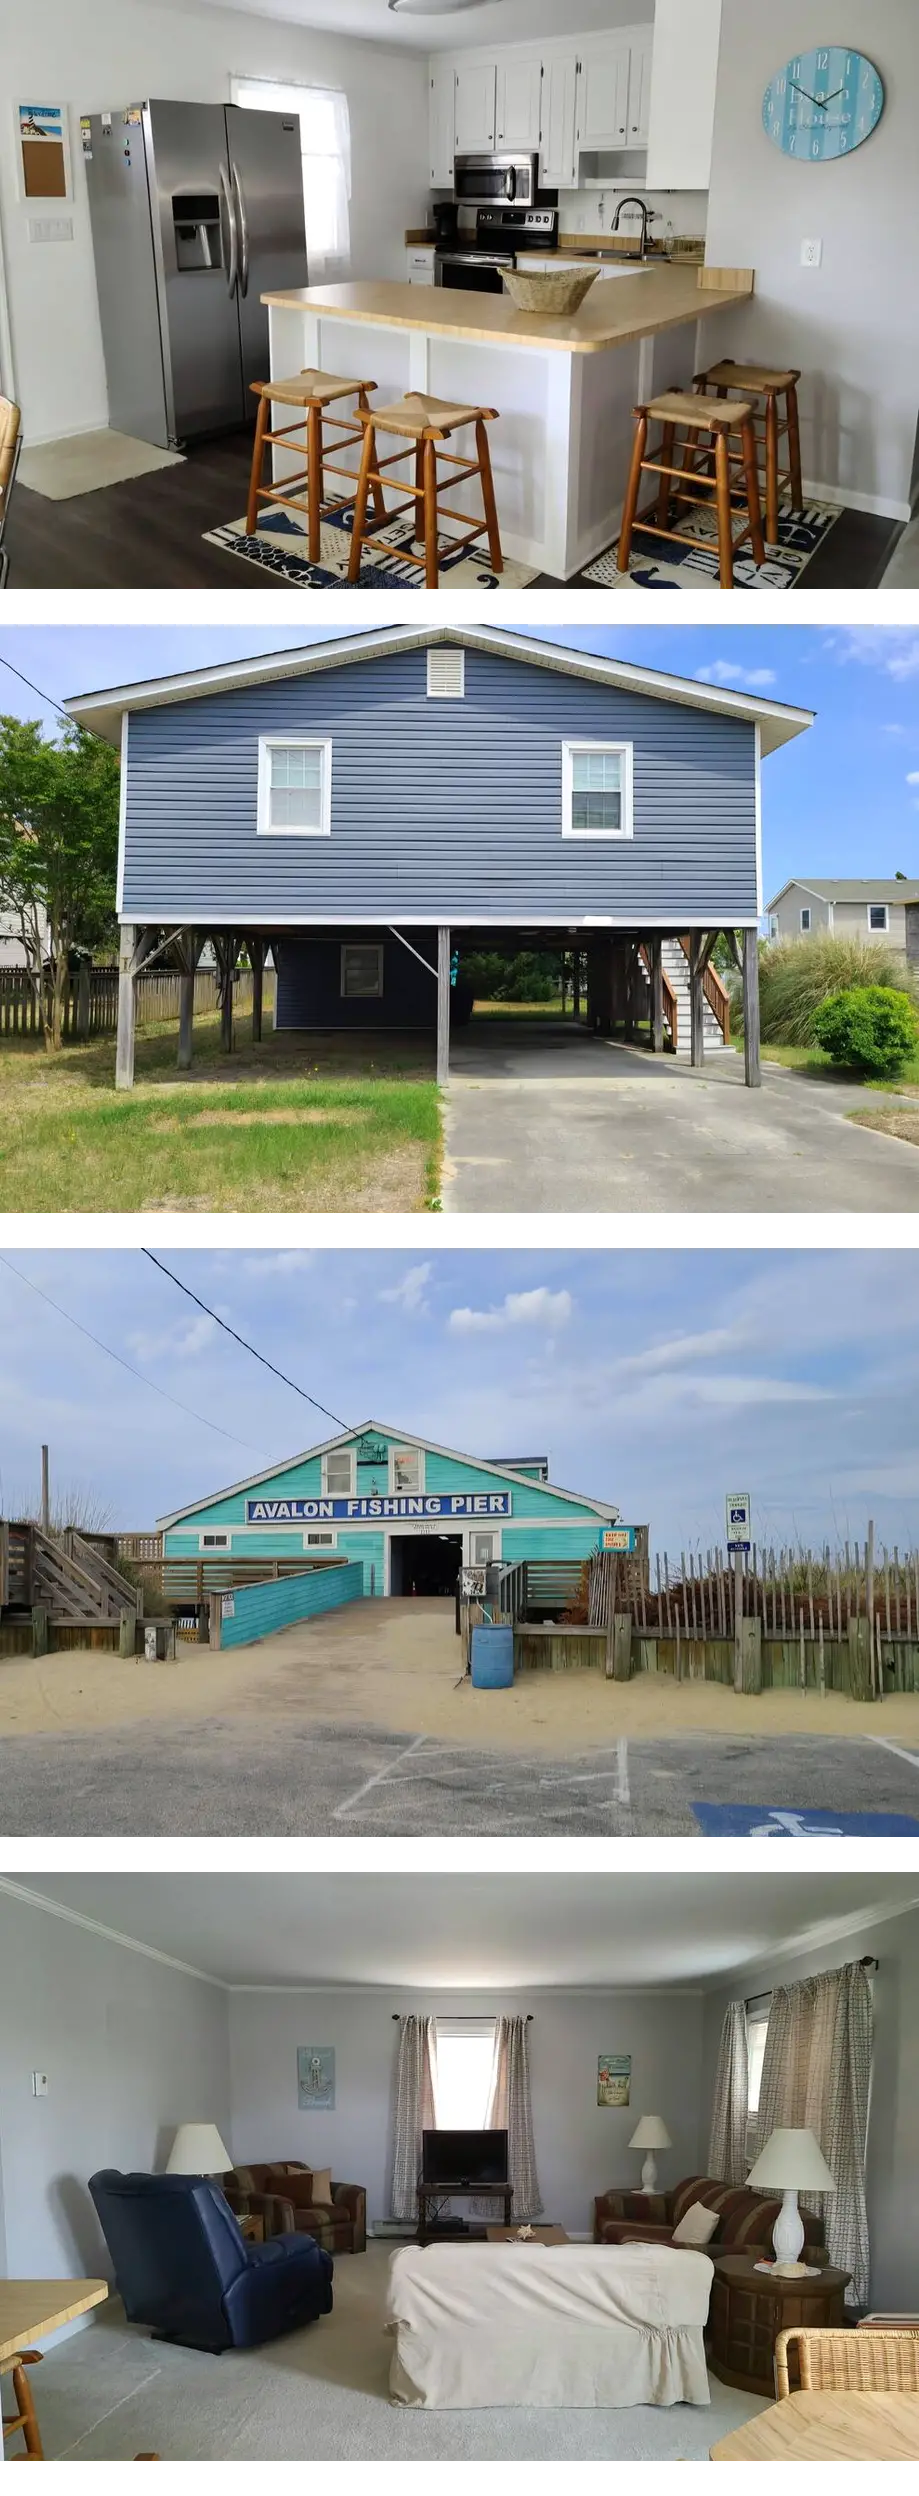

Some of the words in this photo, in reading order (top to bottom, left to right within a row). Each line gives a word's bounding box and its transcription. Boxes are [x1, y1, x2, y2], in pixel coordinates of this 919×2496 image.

[817, 52, 828, 70] 12
[846, 59, 851, 75] 1
[792, 61, 800, 79] 11
[776, 78, 787, 95] 10
[861, 71, 869, 89] 2
[767, 101, 774, 116] 9
[869, 94, 875, 110] 3
[773, 120, 780, 137] 8
[789, 136, 796, 151] 7
[812, 139, 819, 156] 6
[840, 131, 847, 148] 5
[252, 1501, 334, 1519] AVALON
[347, 1498, 441, 1516] FISHING
[451, 1496, 505, 1513] PIER
